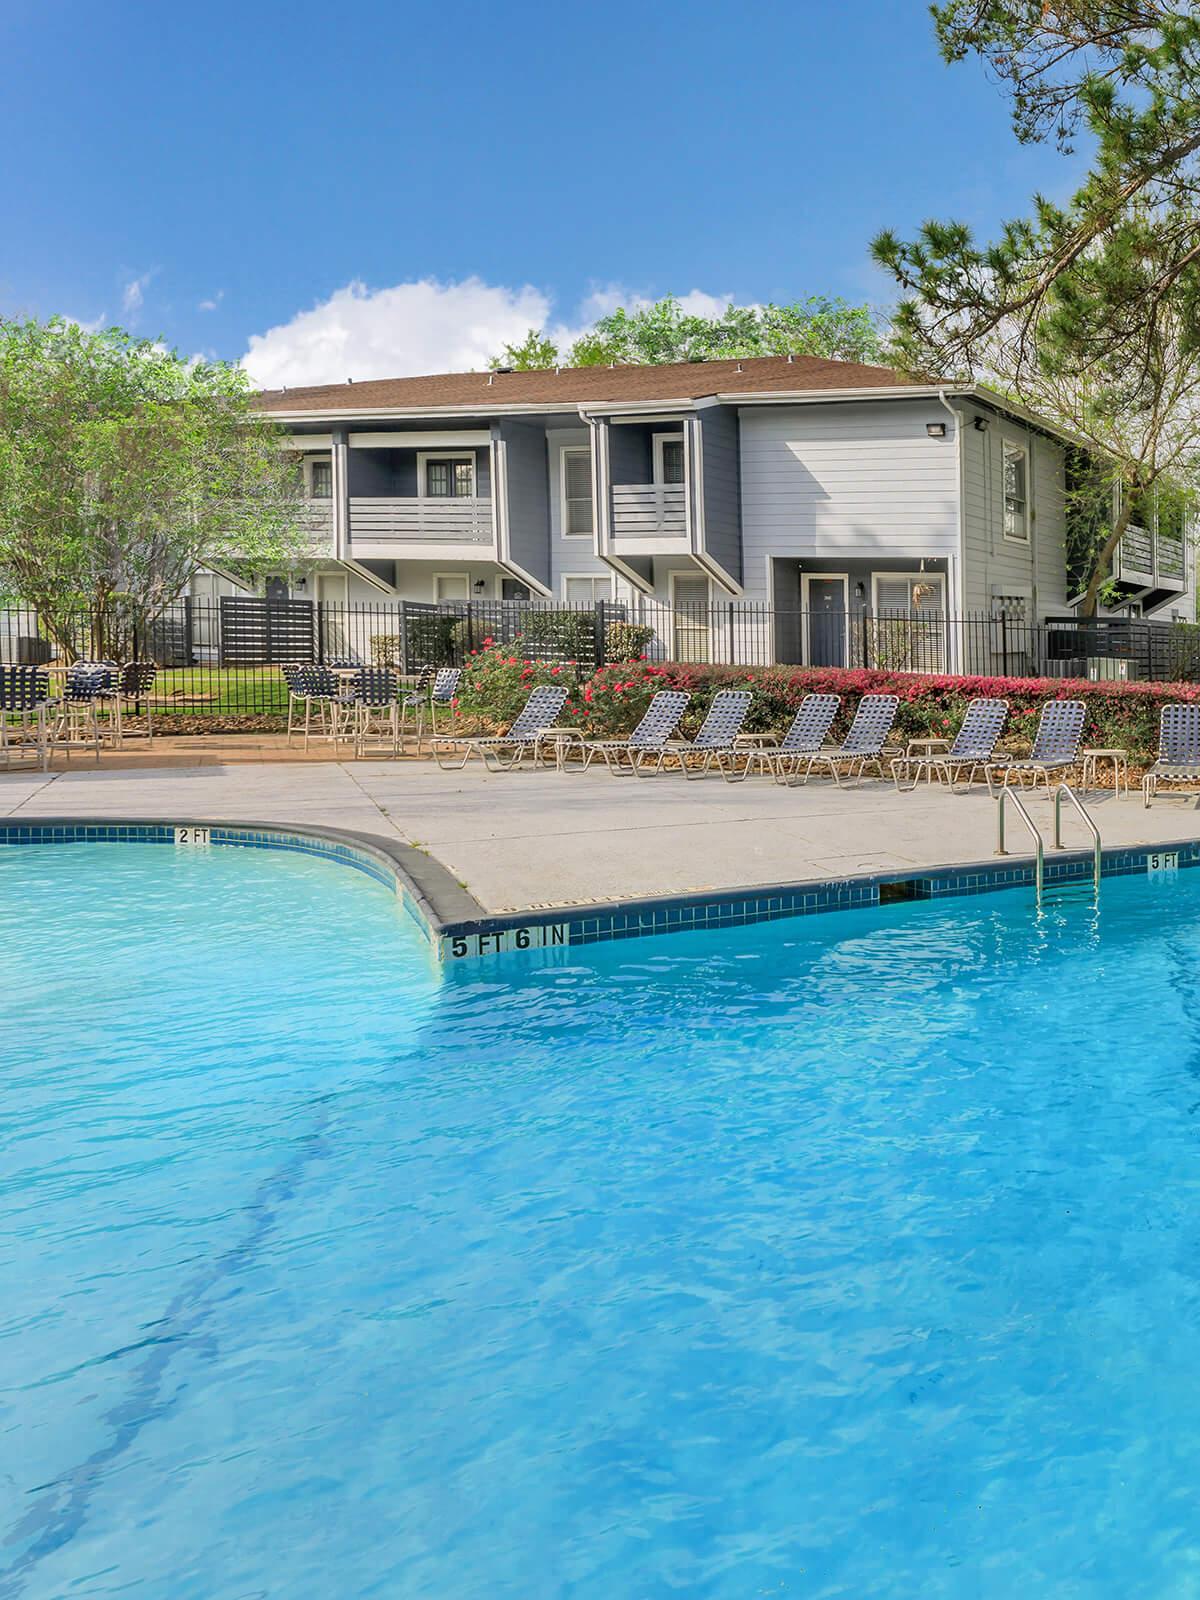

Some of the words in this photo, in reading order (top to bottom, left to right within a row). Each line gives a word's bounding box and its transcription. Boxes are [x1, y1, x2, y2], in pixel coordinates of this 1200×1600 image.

[179, 829, 188, 843] 2
[194, 829, 208, 843] FT
[1152, 855, 1159, 869] 5
[1164, 853, 1176, 869] FT
[452, 936, 468, 958] 5
[479, 932, 504, 955] FT
[515, 929, 530, 949] 6
[543, 925, 564, 946] IN
